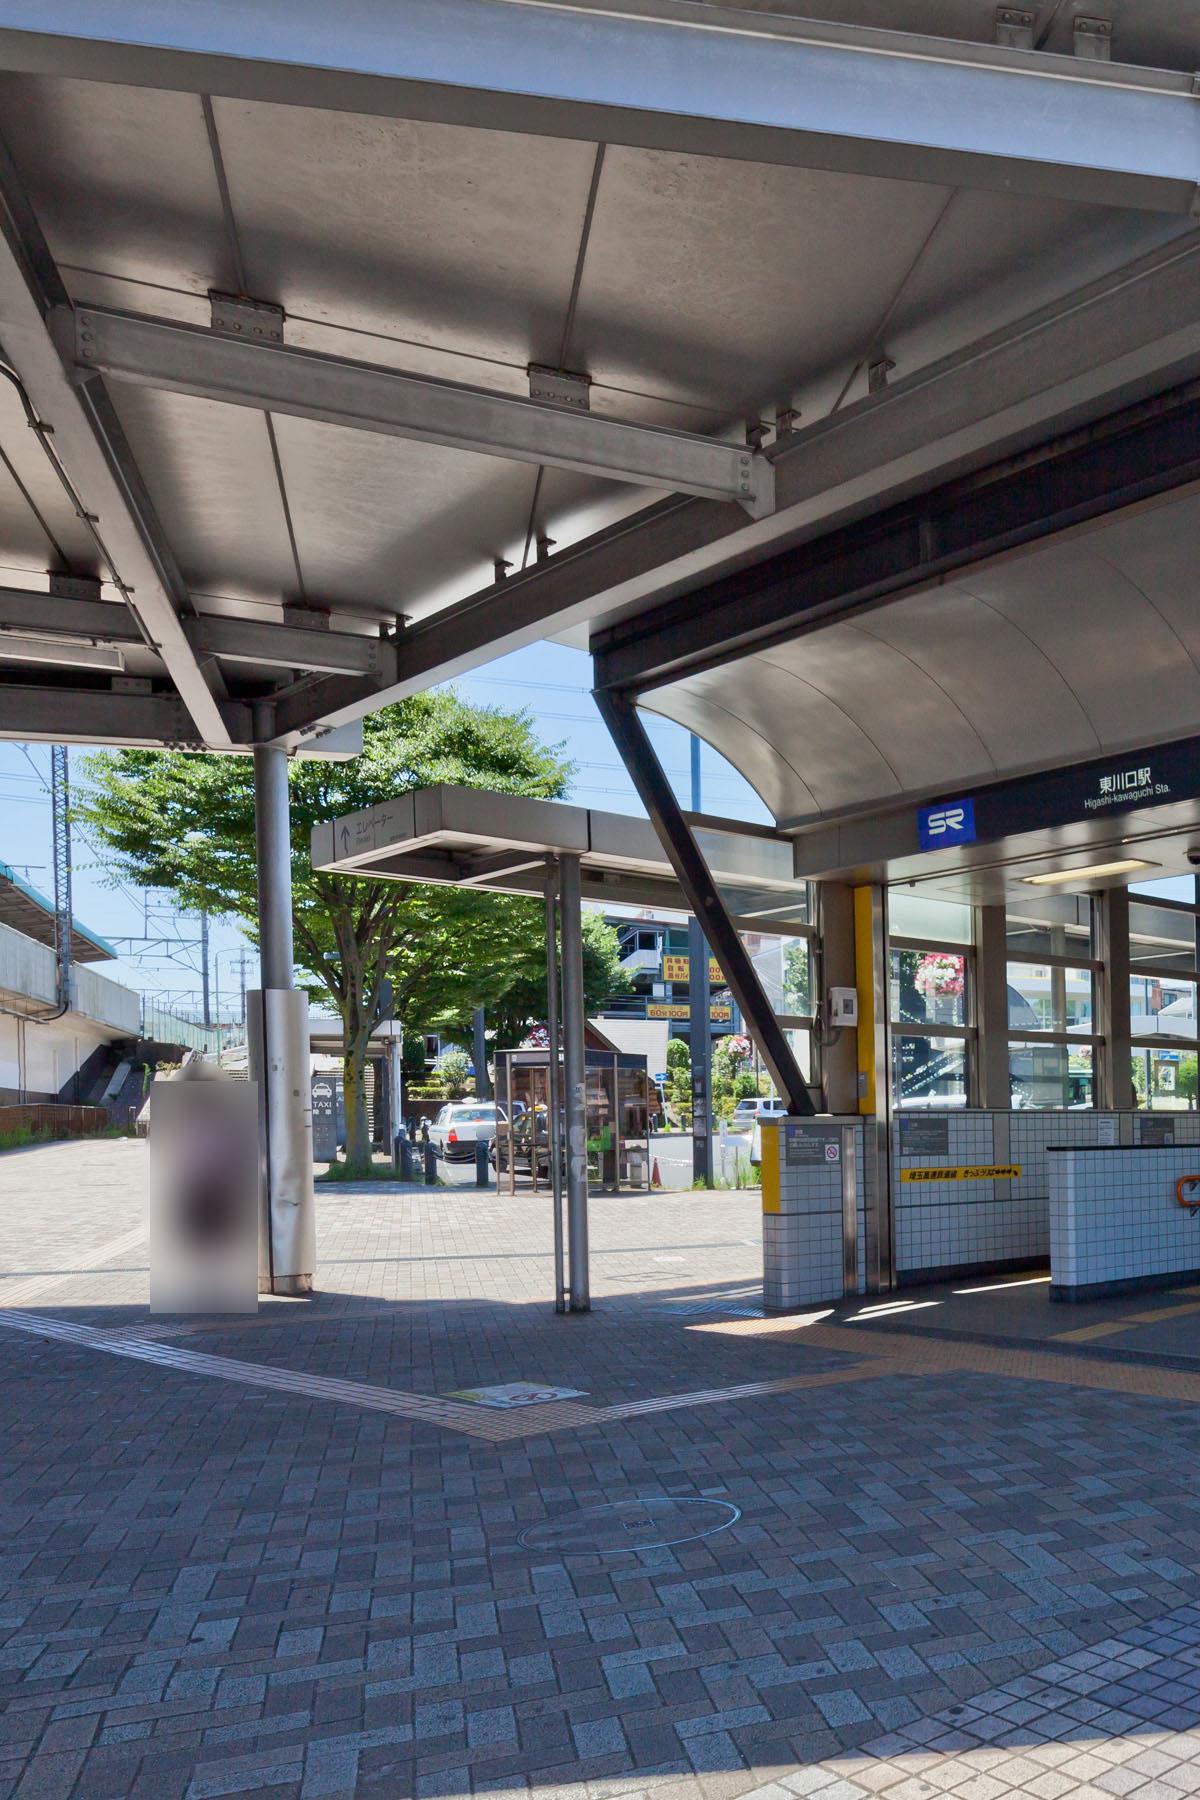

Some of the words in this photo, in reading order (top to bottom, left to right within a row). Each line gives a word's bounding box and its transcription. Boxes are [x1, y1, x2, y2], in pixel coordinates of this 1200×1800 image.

[1098, 767, 1152, 794] 東川口駅
[1084, 786, 1154, 809] Higashi-kawaguchi
[928, 808, 964, 835] SR
